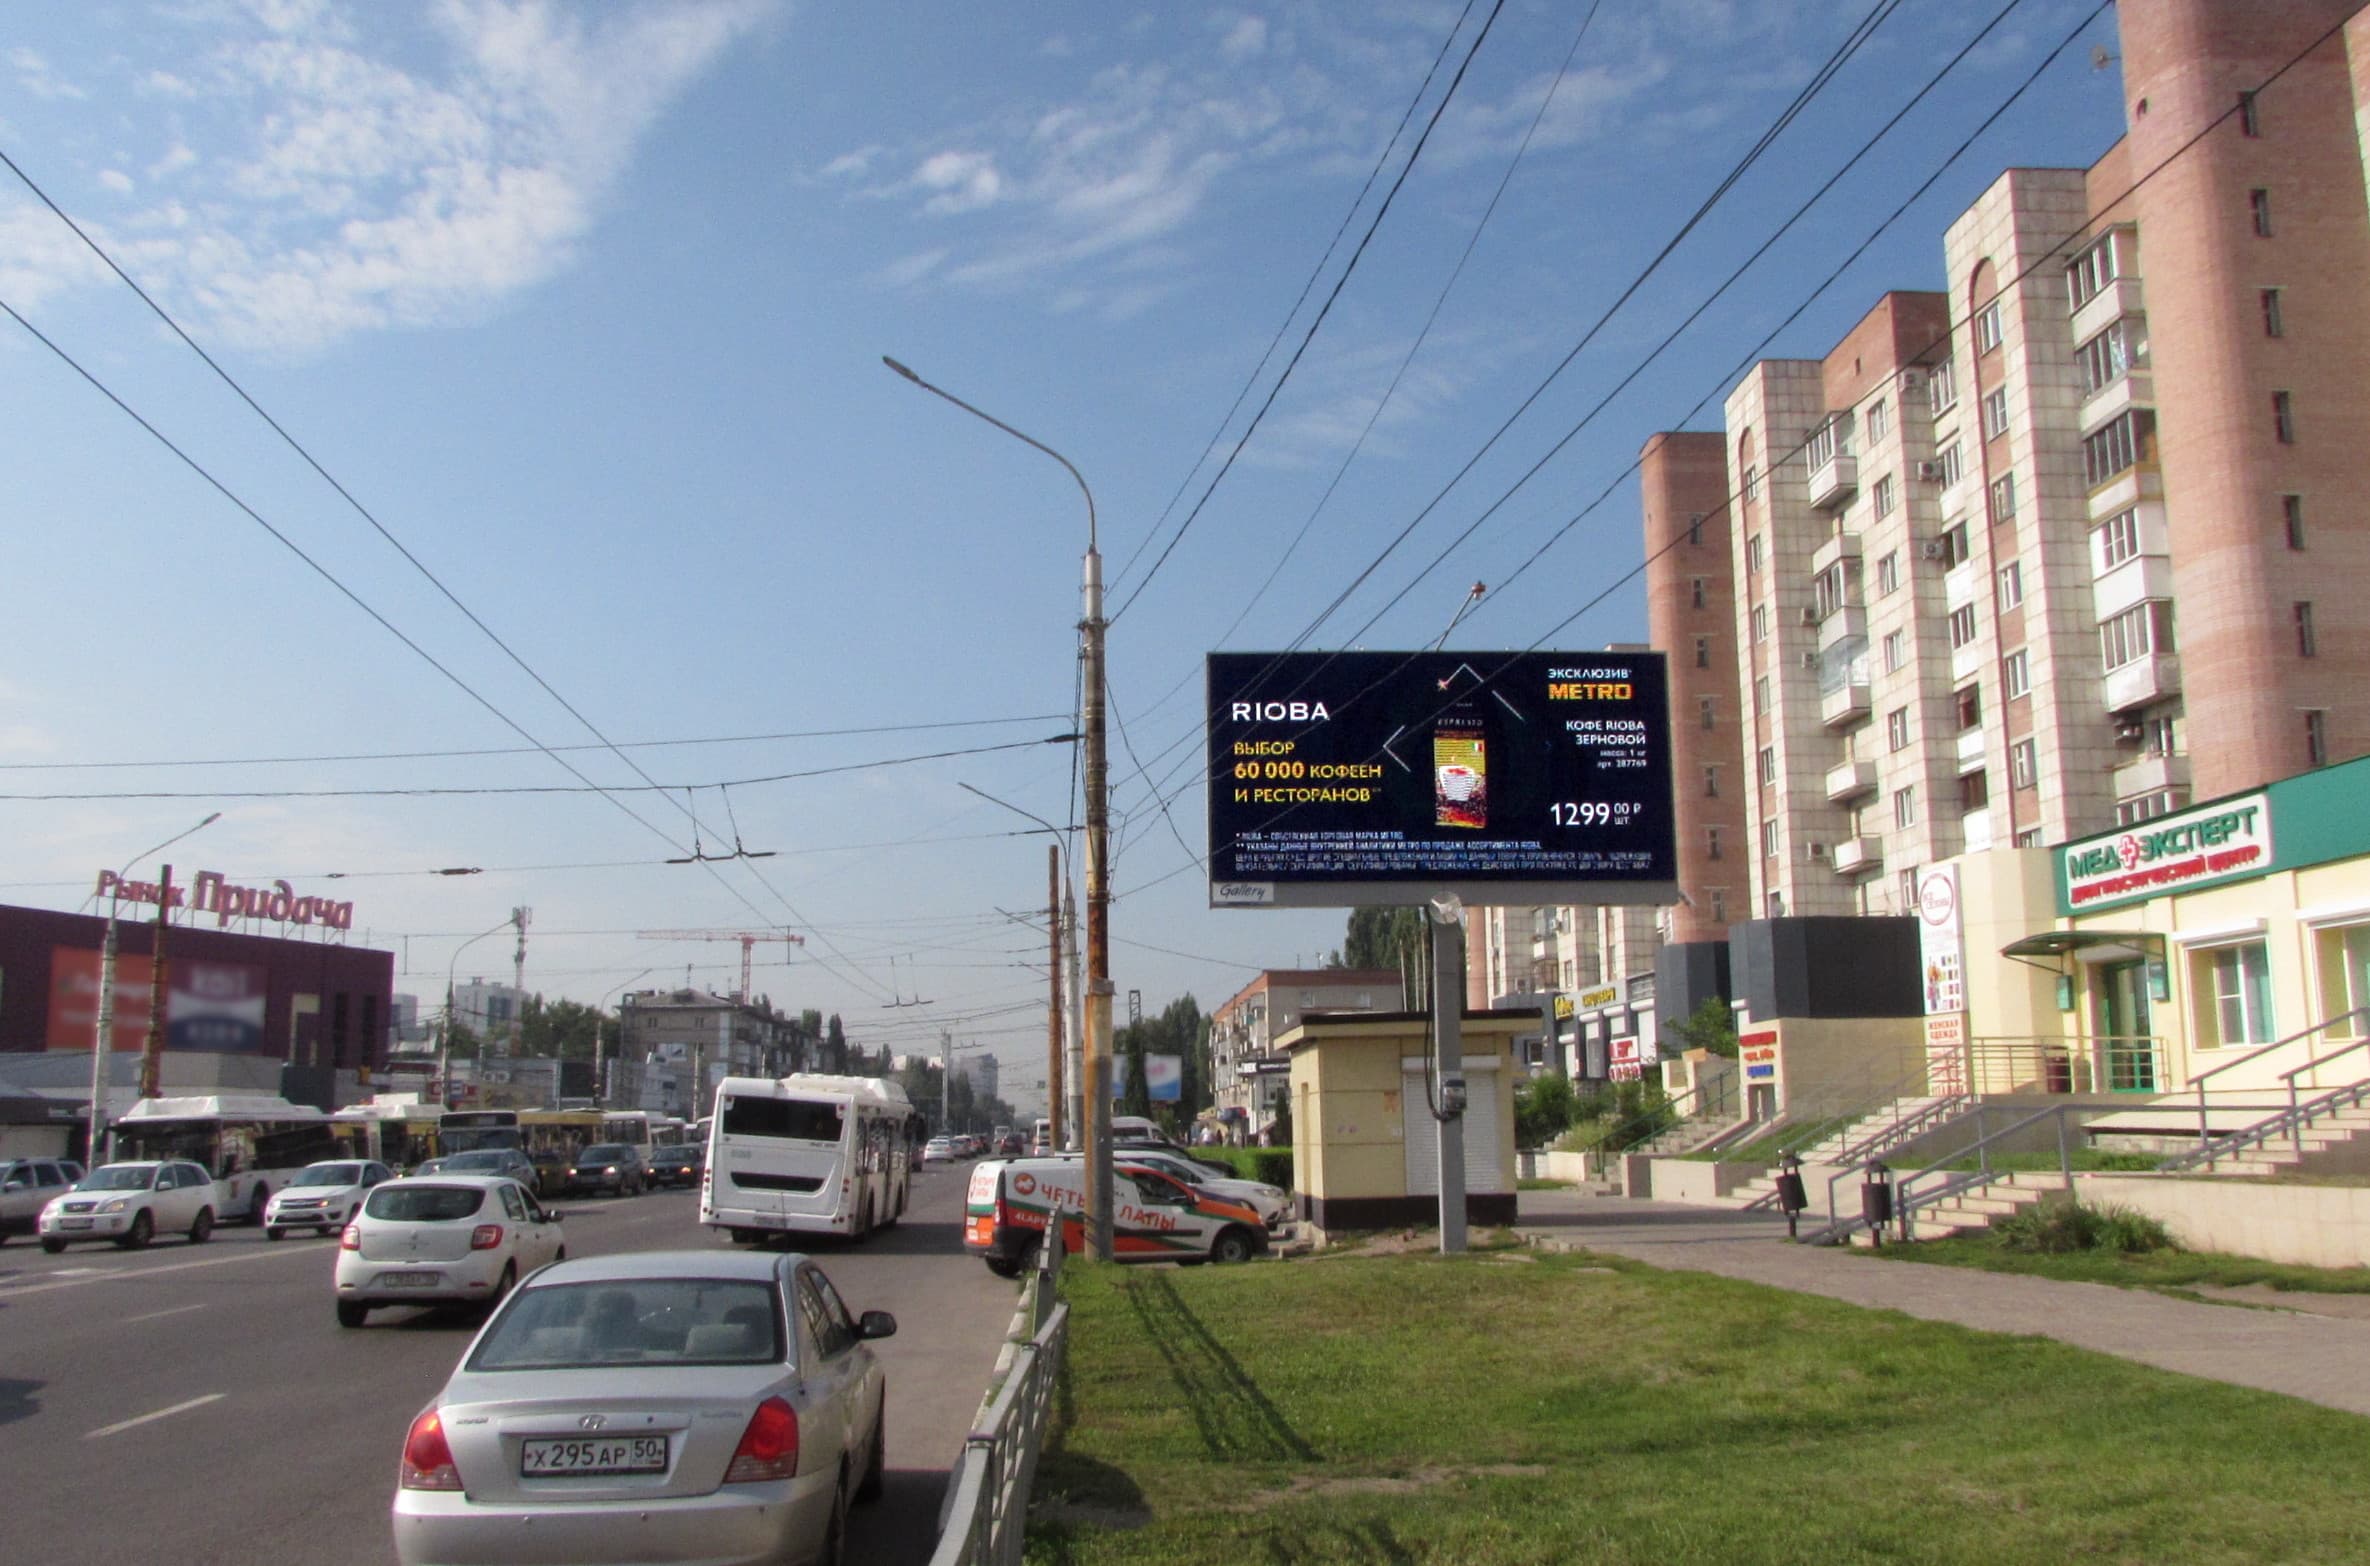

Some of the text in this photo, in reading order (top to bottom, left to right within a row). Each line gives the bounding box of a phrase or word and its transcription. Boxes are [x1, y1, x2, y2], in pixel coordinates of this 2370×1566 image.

[1548, 683, 1633, 700] METRO
[1232, 702, 1330, 721] RIOBA
[1566, 720, 1645, 731] КОФЕ RIOBA
[1576, 732, 1646, 745] ЗЕРНОВОЙ
[1234, 741, 1295, 755] ВЫБОР
[1234, 761, 1382, 779] 60 000 КОФЕЕН
[1234, 788, 1248, 803] И
[1550, 803, 1610, 826] 1299
[1614, 803, 1629, 814] 00
[2068, 805, 2258, 880] МЕД ЭКСПЕРТ
[193, 870, 353, 928] Придача
[1220, 883, 1266, 900] Gallery
[1119, 1205, 1176, 1230] ЛАПЫ
